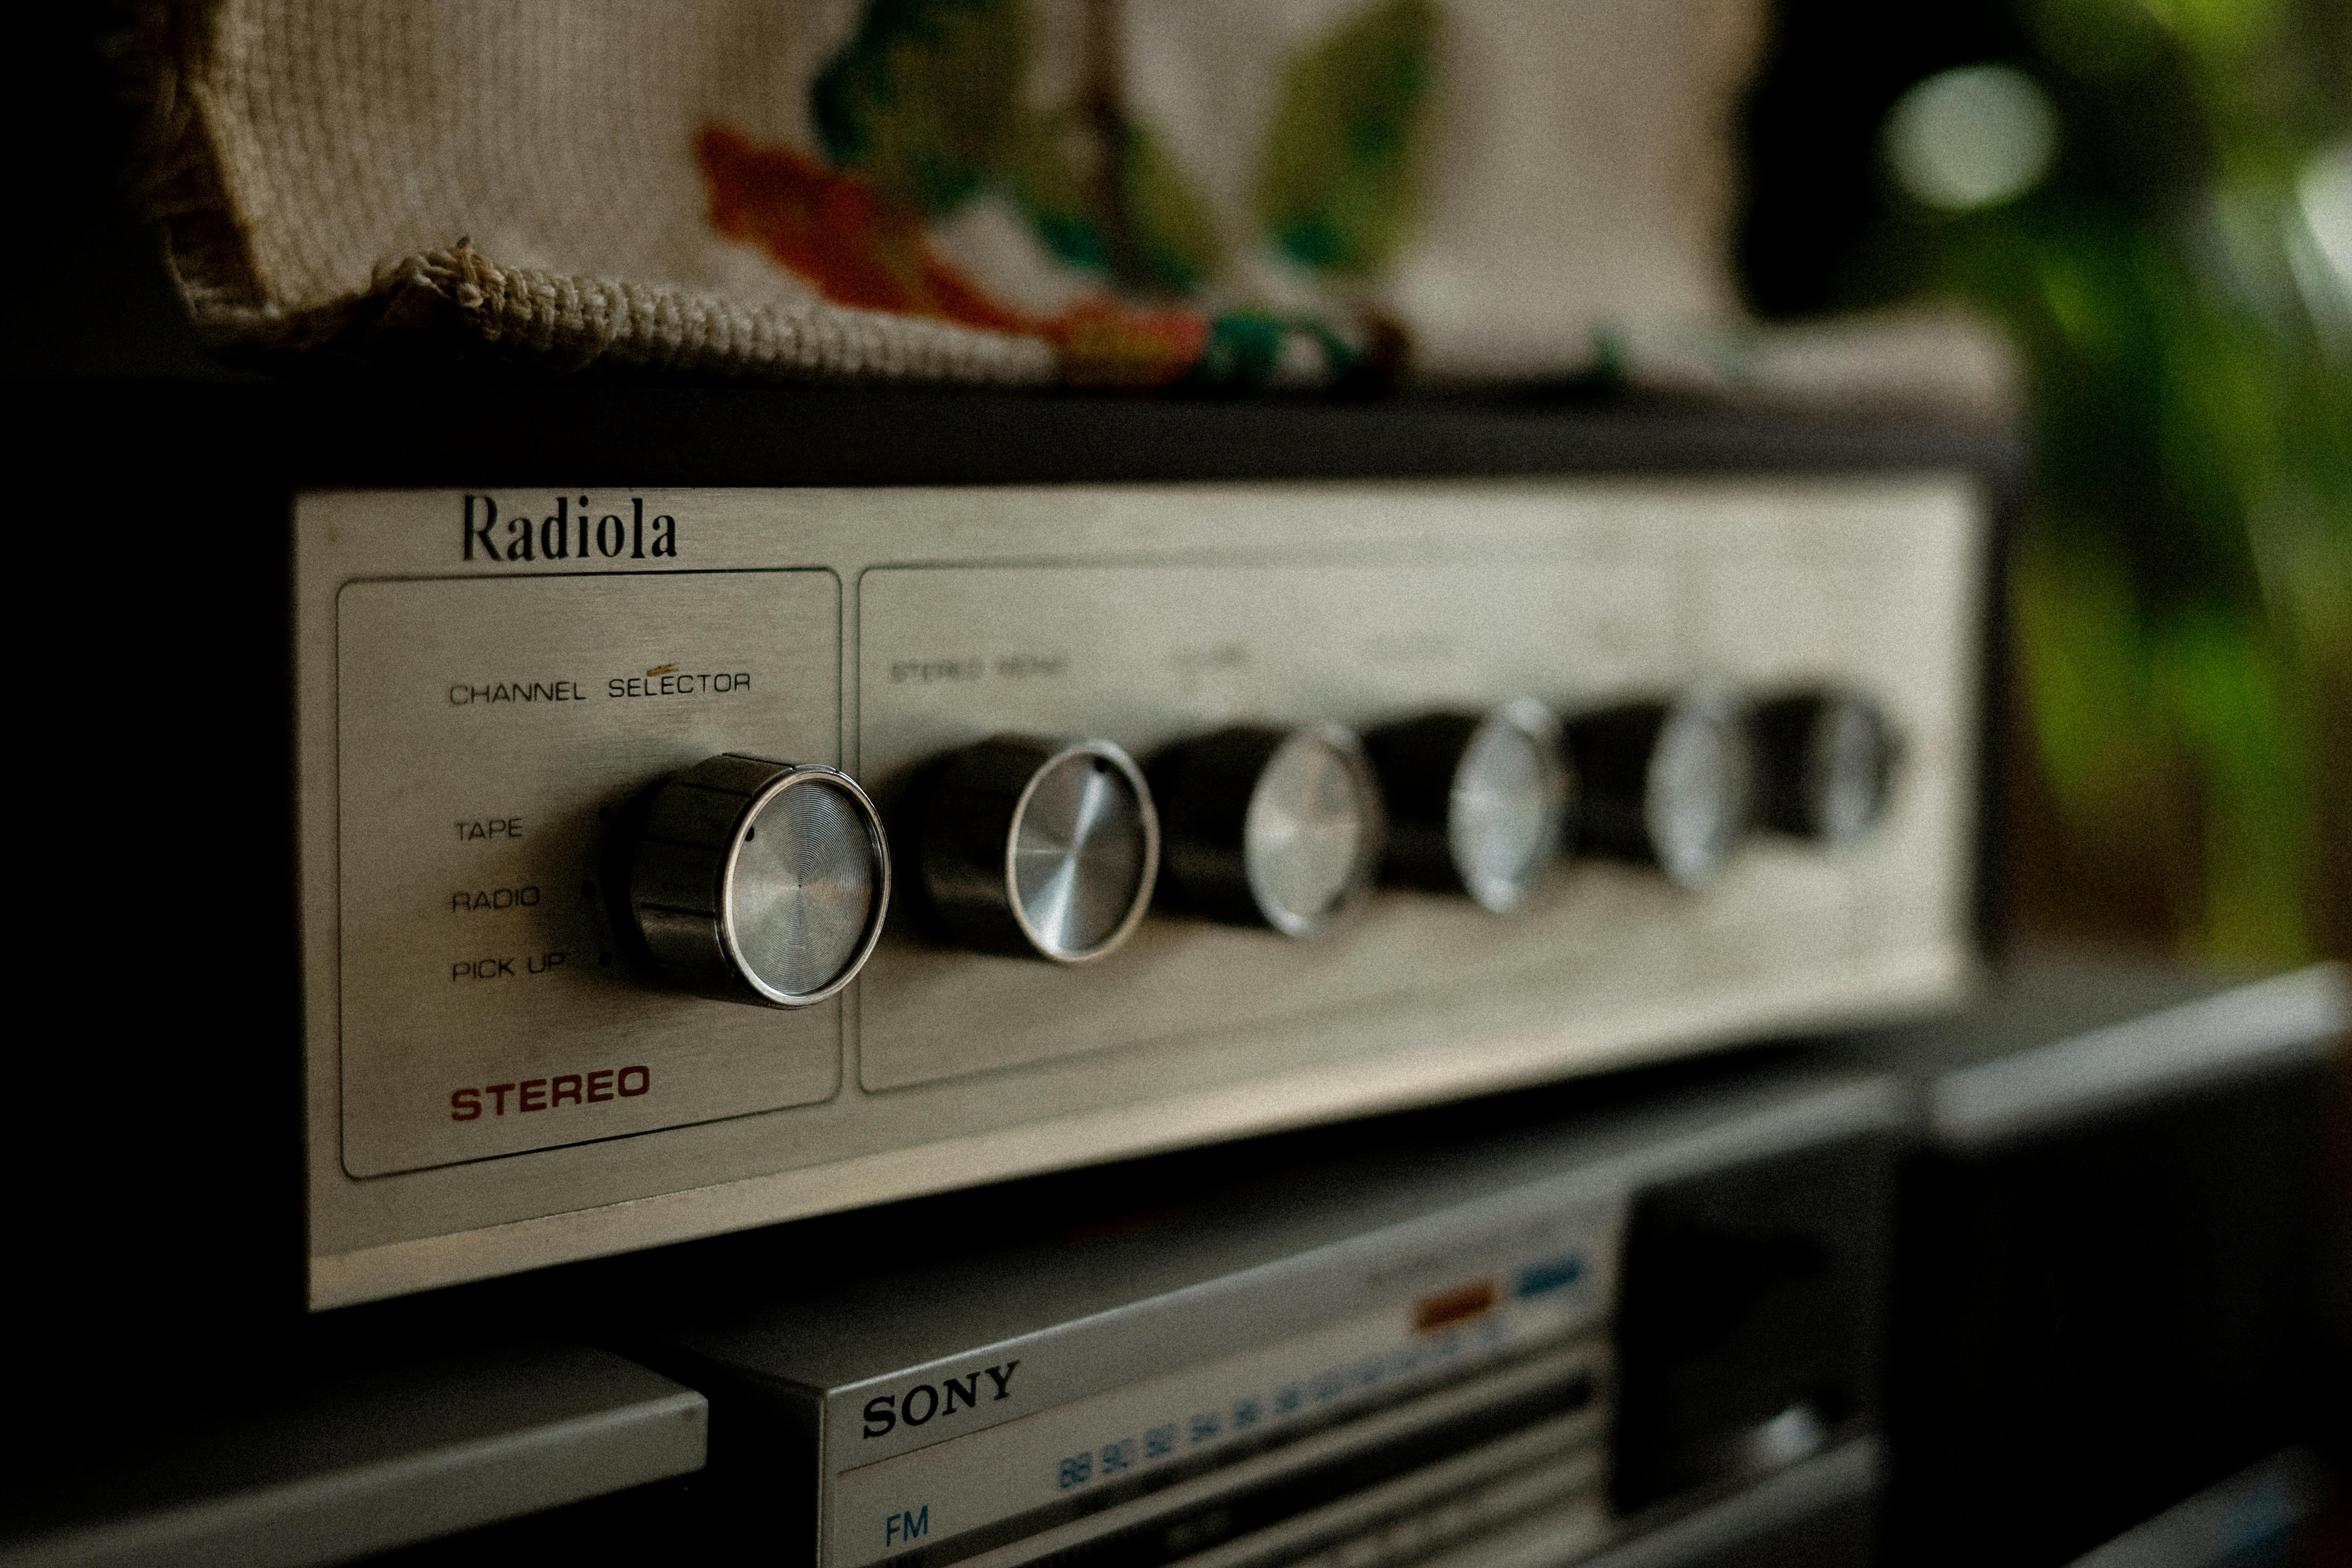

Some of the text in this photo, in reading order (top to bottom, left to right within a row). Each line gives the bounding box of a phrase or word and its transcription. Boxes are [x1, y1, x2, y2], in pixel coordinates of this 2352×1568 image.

[461, 495, 678, 562] Radiola
[449, 672, 751, 706] CHANNEL SELECTOR
[455, 817, 524, 841] TAPE
[452, 886, 541, 913] RADIO
[452, 952, 566, 982] PICK UP
[451, 1065, 651, 1122] STEREO
[862, 1359, 1020, 1439] SONY
[886, 1505, 928, 1547] FM
